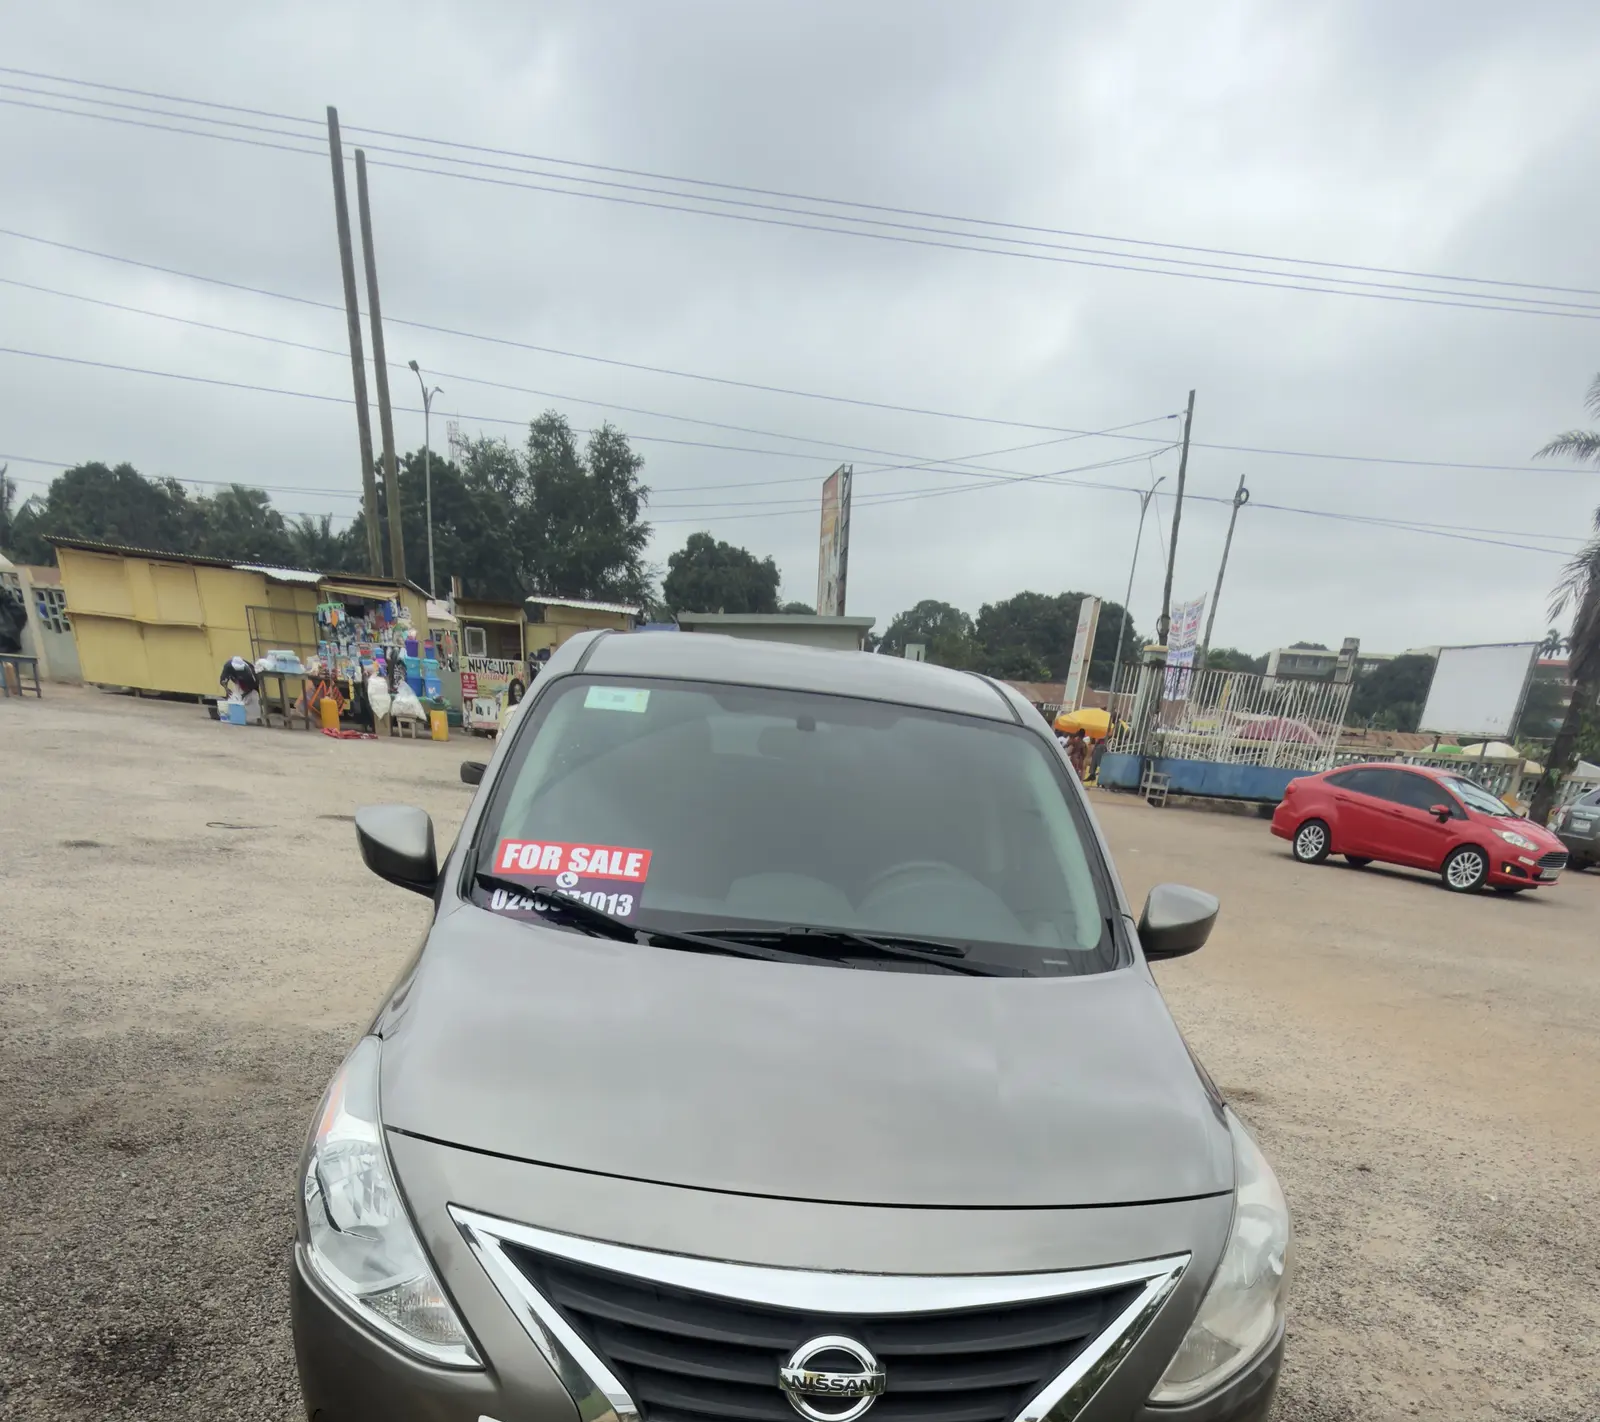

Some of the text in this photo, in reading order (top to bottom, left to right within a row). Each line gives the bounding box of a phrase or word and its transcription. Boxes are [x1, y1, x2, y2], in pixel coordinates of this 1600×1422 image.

[501, 843, 644, 878] FOR SALE
[791, 1375, 875, 1392] NISSAN
